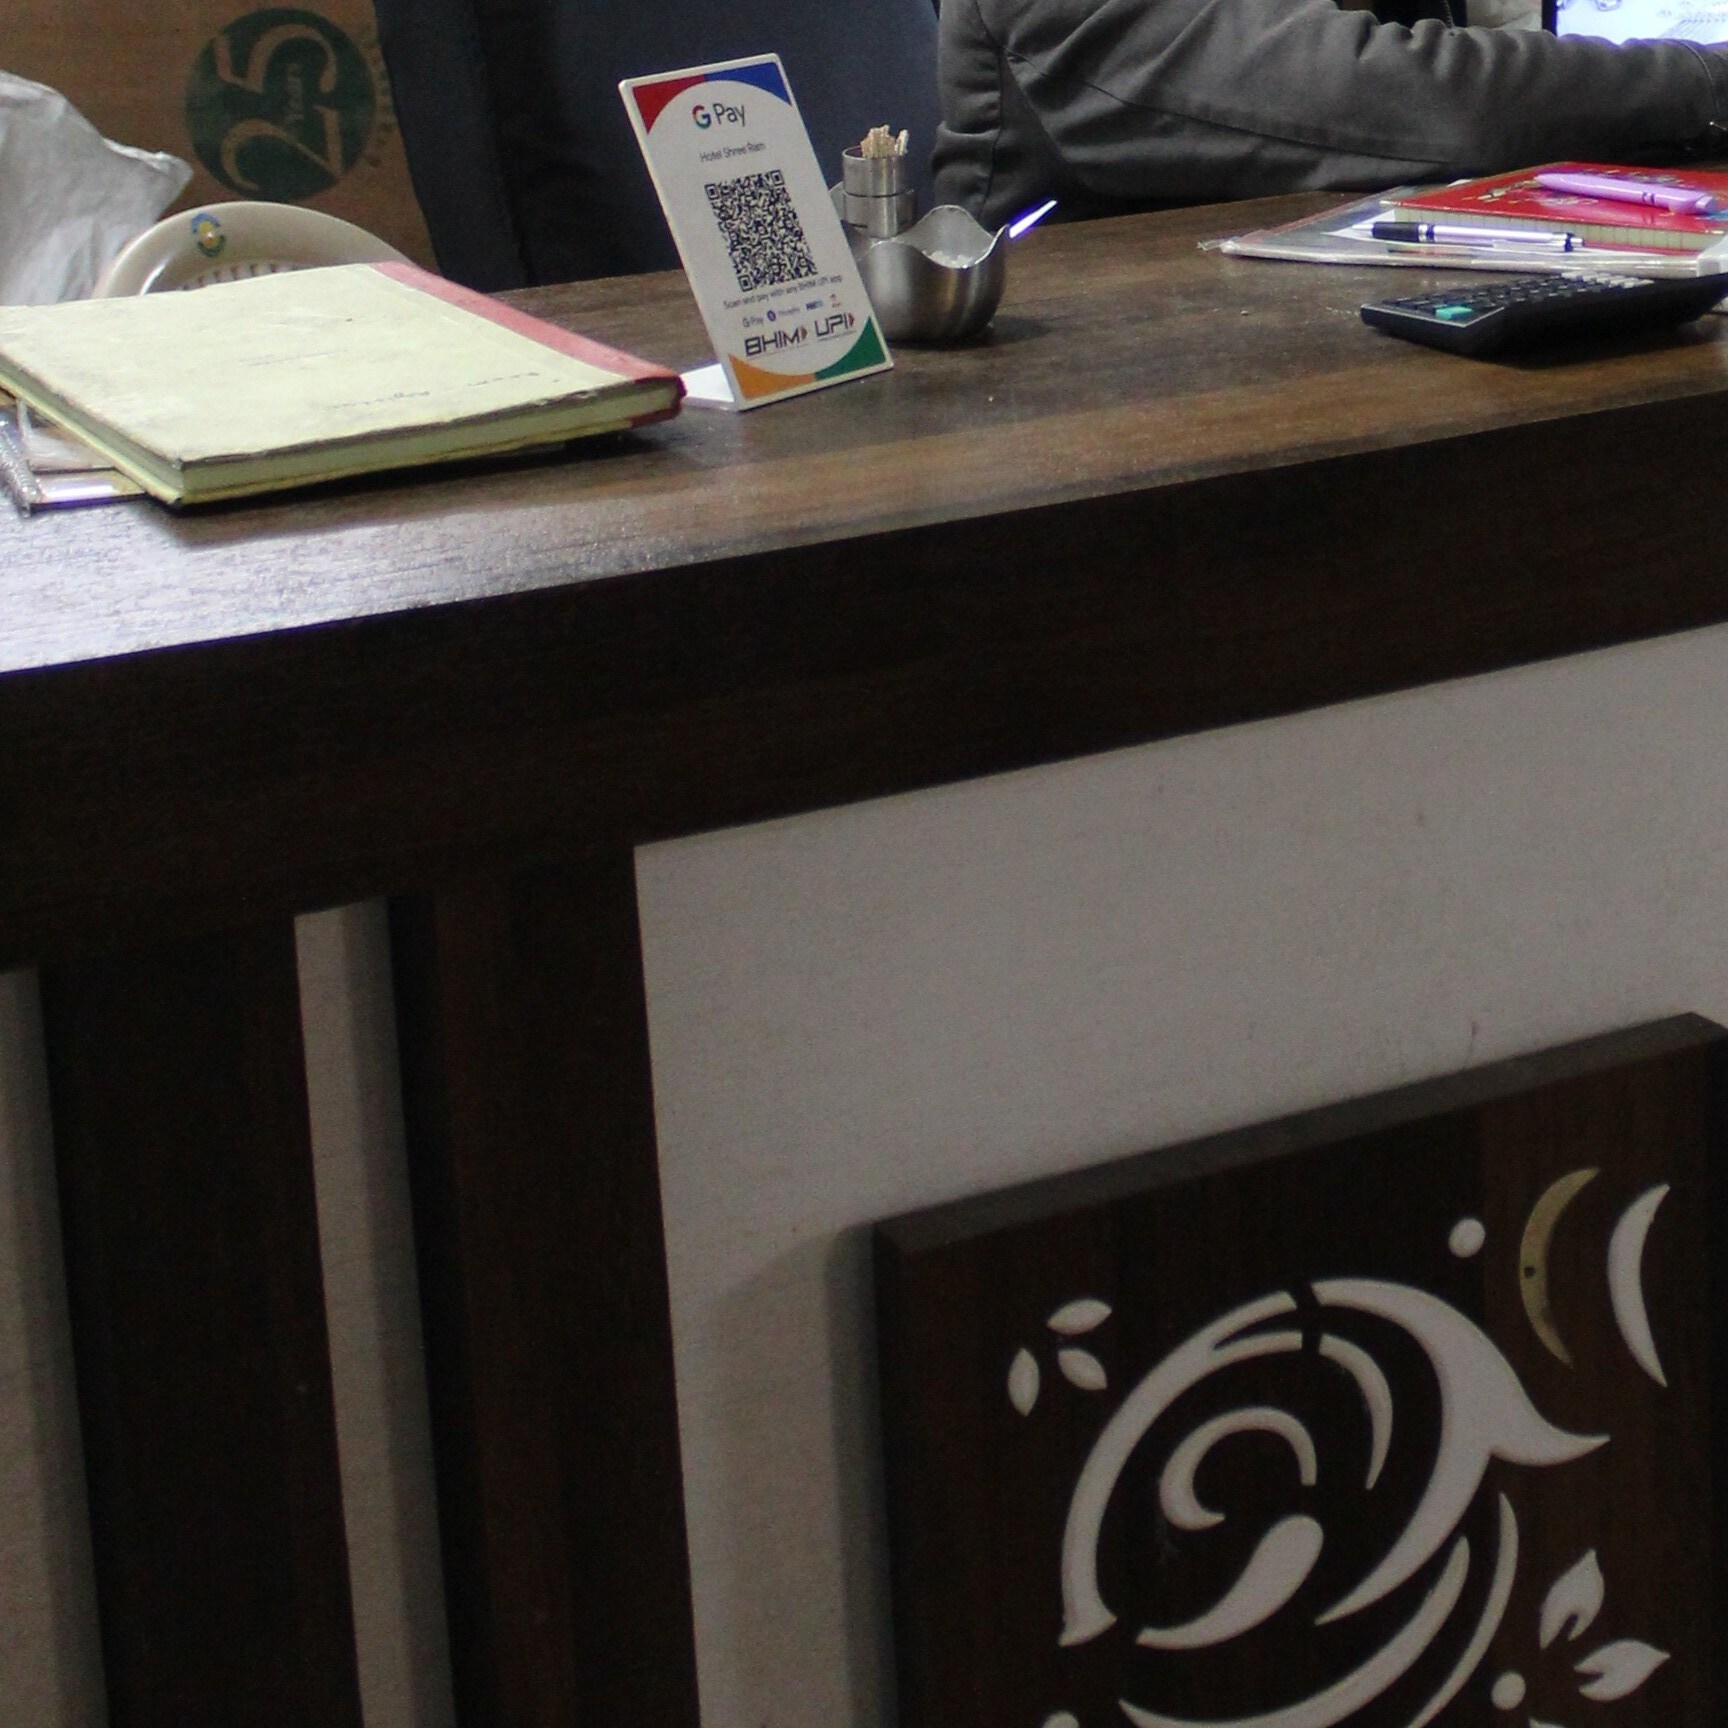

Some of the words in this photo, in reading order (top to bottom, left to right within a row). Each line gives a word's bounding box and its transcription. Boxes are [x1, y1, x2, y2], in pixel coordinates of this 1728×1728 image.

[713, 103, 746, 127] Pay
[744, 327, 800, 356] BHIM
[814, 313, 849, 337] UPI
